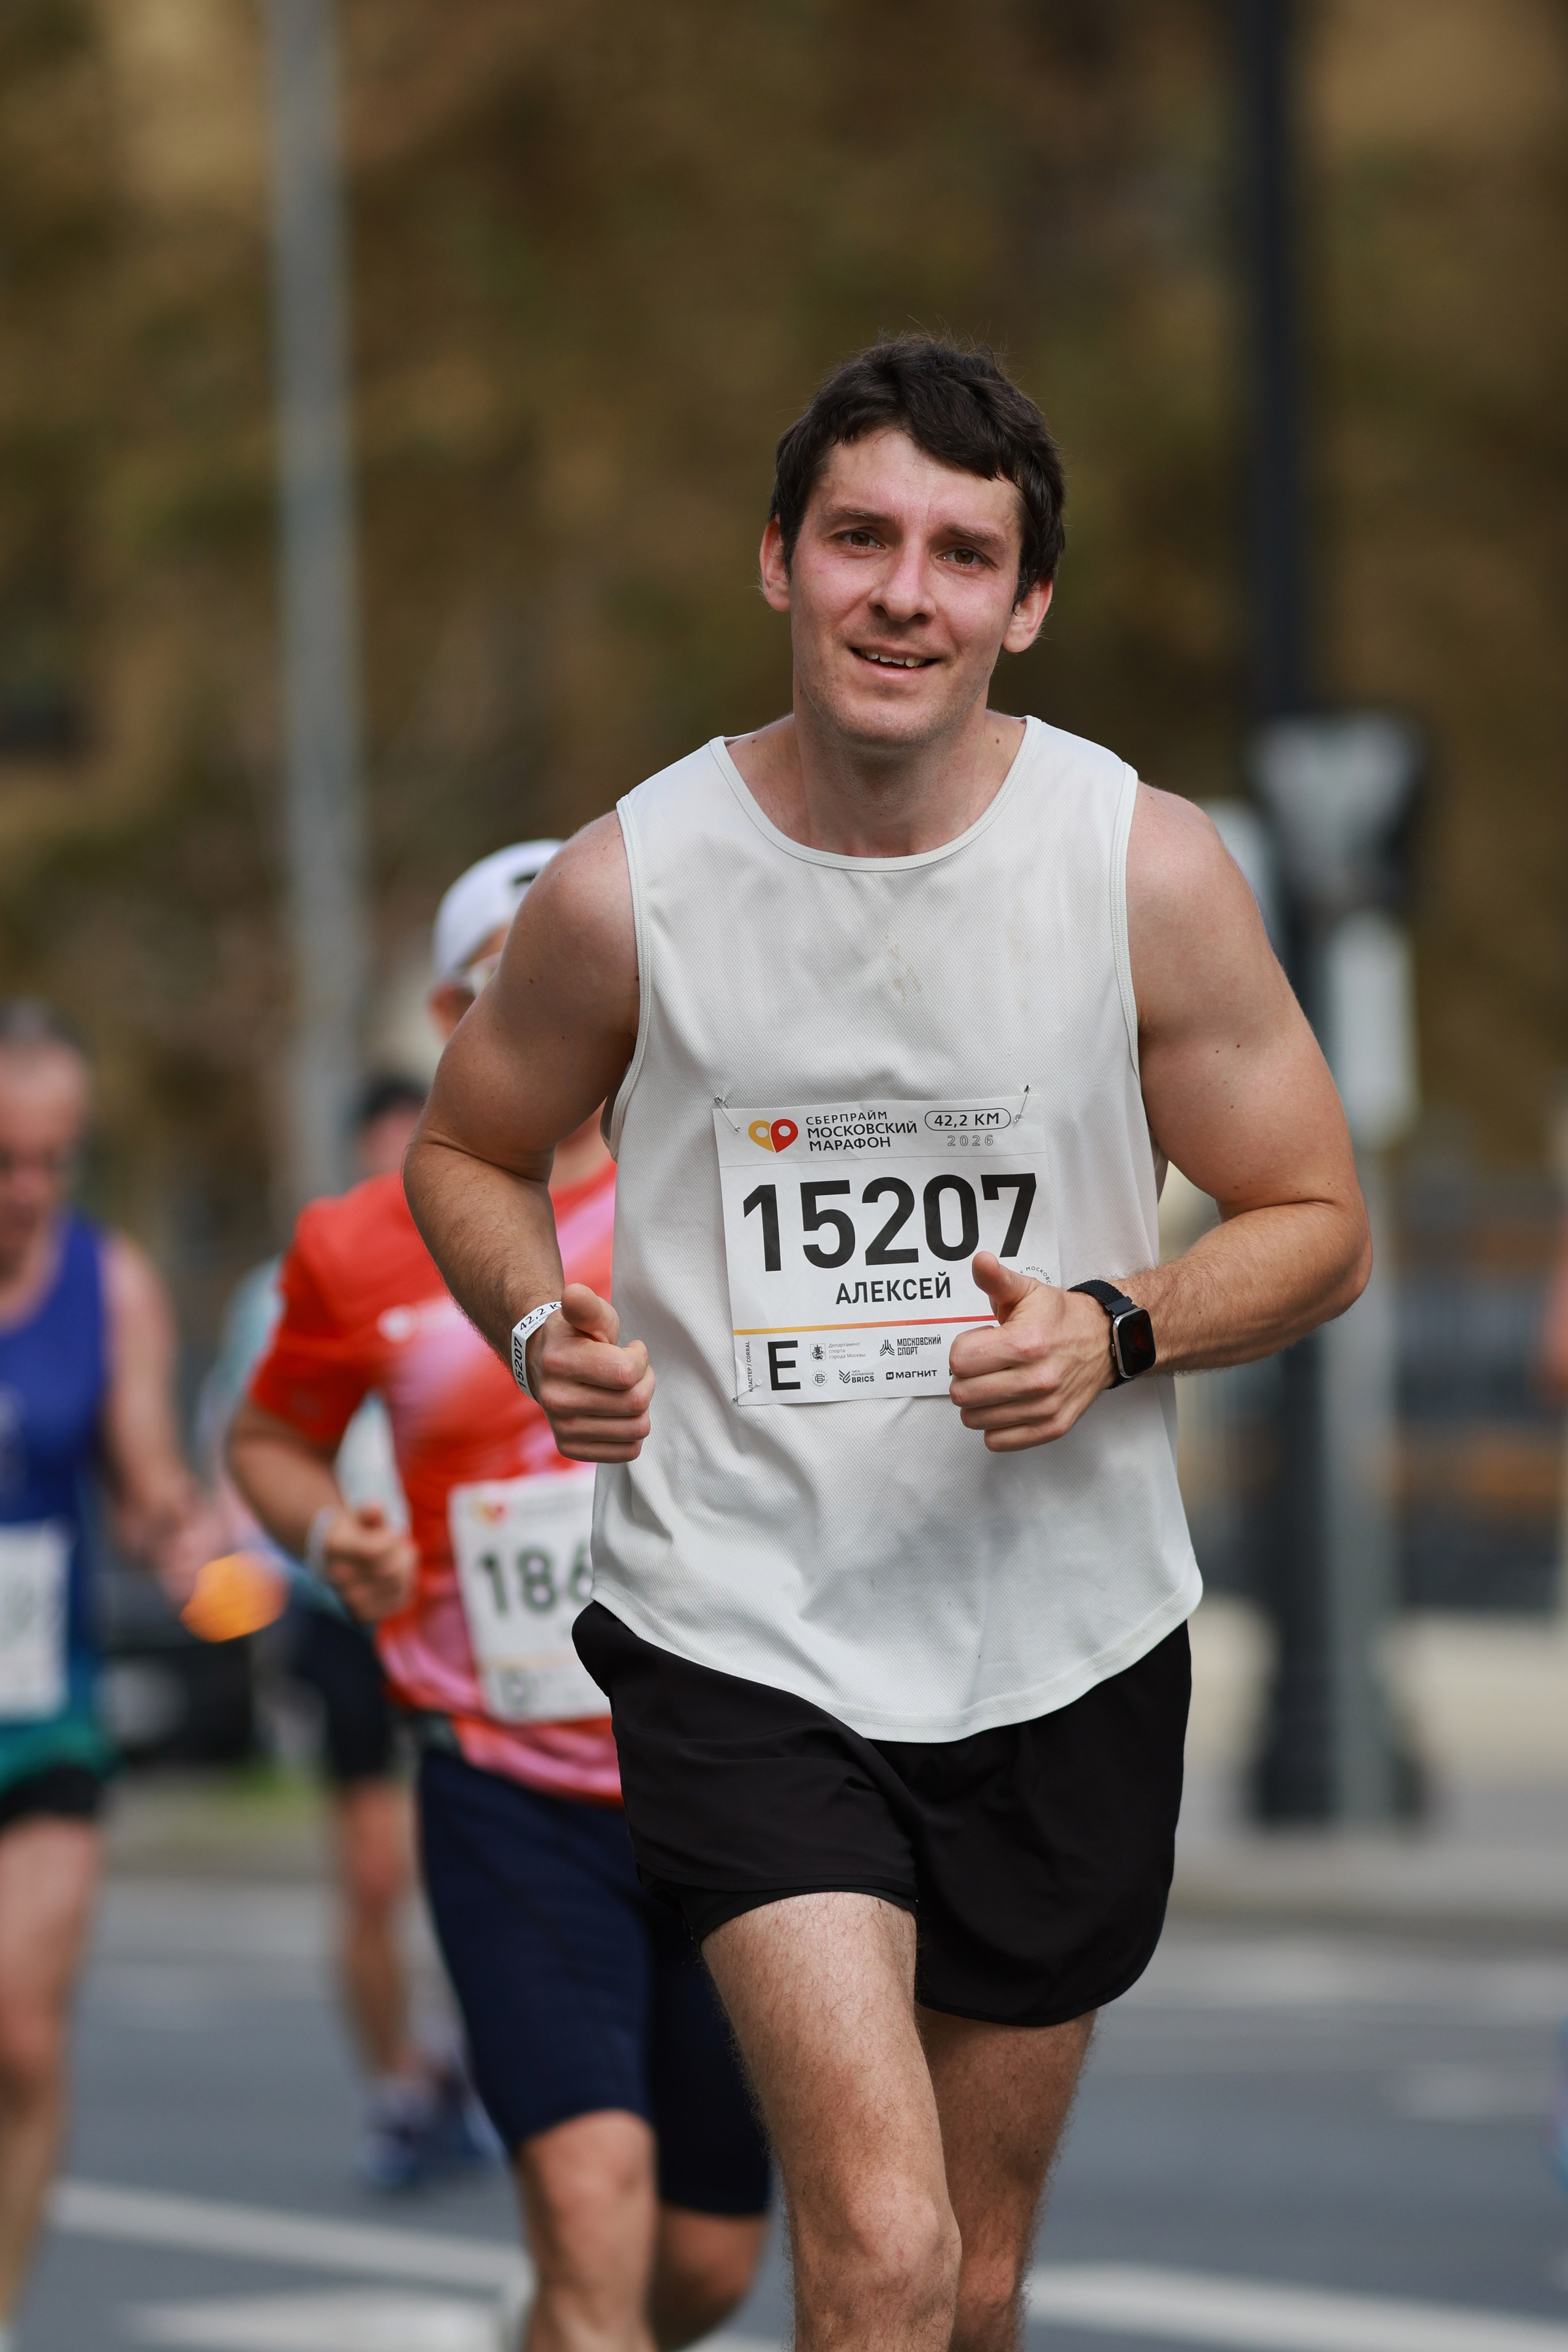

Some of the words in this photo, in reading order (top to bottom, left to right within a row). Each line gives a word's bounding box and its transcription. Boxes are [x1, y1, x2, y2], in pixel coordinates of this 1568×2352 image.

[806, 1110, 888, 1125] СБЕРПРАЙМ
[934, 1114, 968, 1128] 42,2
[974, 1112, 999, 1126] КМ
[807, 1120, 918, 1138] МОСКОВСКИЙ
[809, 1136, 891, 1152] МАРАФОН
[947, 1134, 993, 1146] 2026
[742, 1173, 1037, 1272] 15207
[1025, 1266, 1052, 1284] МОСКОВС
[835, 1272, 952, 1305] АЛЕКСЕЙ
[897, 1335, 941, 1347] МОСКОВСКИЙ
[897, 1346, 918, 1355] СПОРТ
[514, 1336, 526, 1388] 15207
[767, 1340, 801, 1390] E
[477, 1539, 592, 1618] 186
